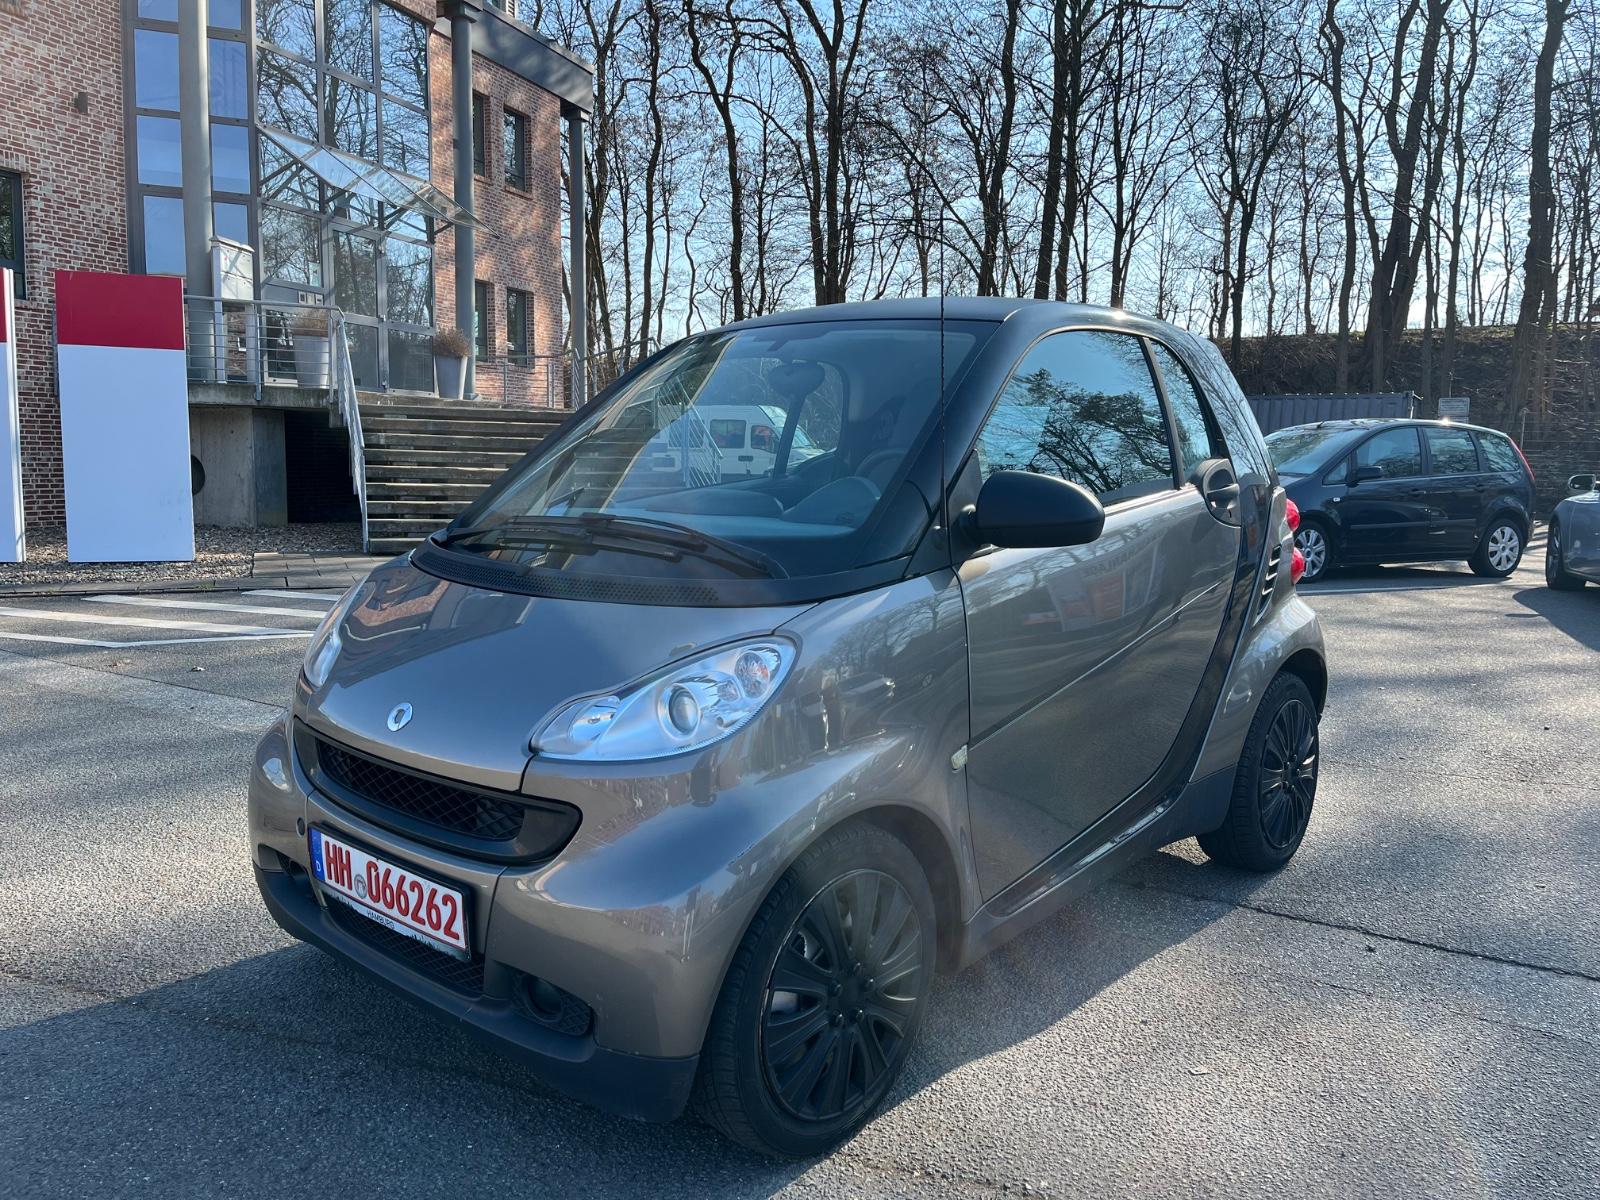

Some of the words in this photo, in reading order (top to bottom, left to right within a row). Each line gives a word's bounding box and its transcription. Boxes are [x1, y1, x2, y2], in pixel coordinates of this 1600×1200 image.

[316, 860, 321, 872] D
[325, 841, 352, 890] HH
[366, 861, 459, 940] 066262
